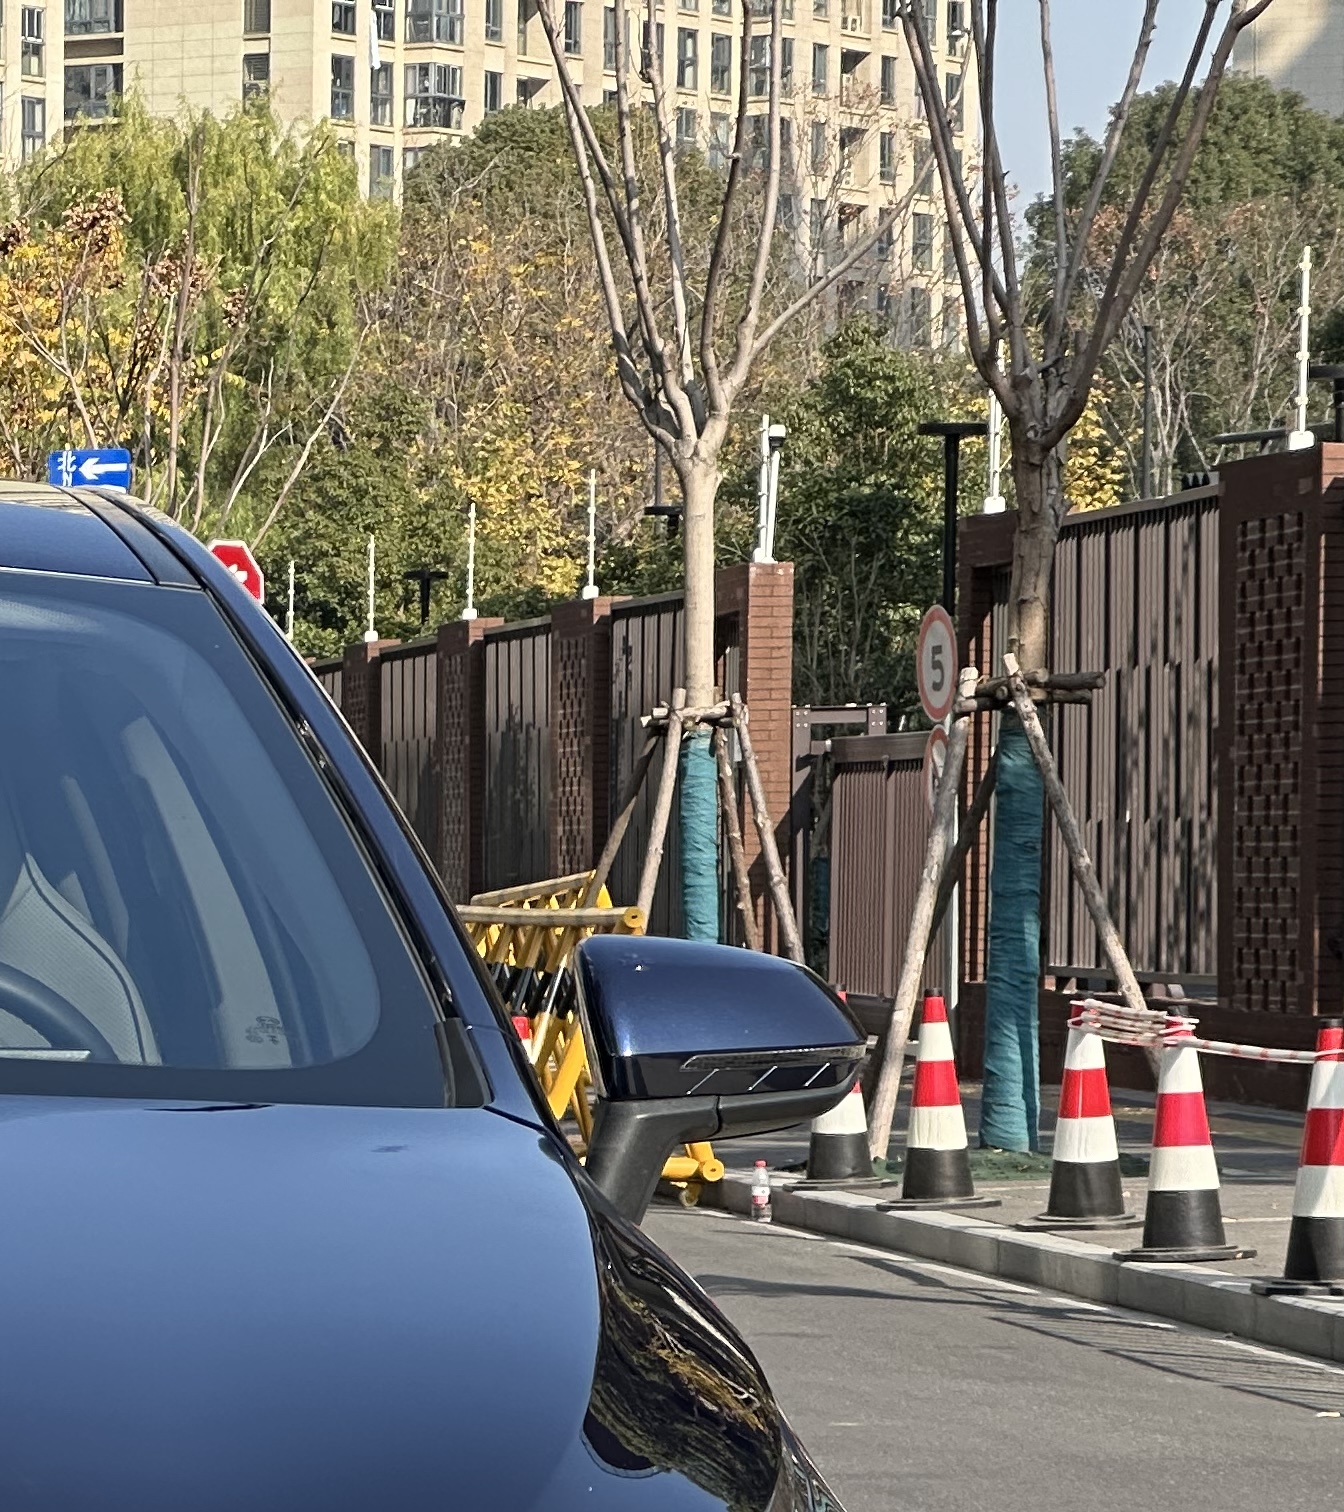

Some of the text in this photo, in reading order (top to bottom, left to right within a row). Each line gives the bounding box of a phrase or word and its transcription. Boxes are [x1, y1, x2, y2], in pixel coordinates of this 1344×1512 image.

[57, 450, 77, 472] 北
[62, 471, 72, 487] N
[930, 645, 945, 692] 5
